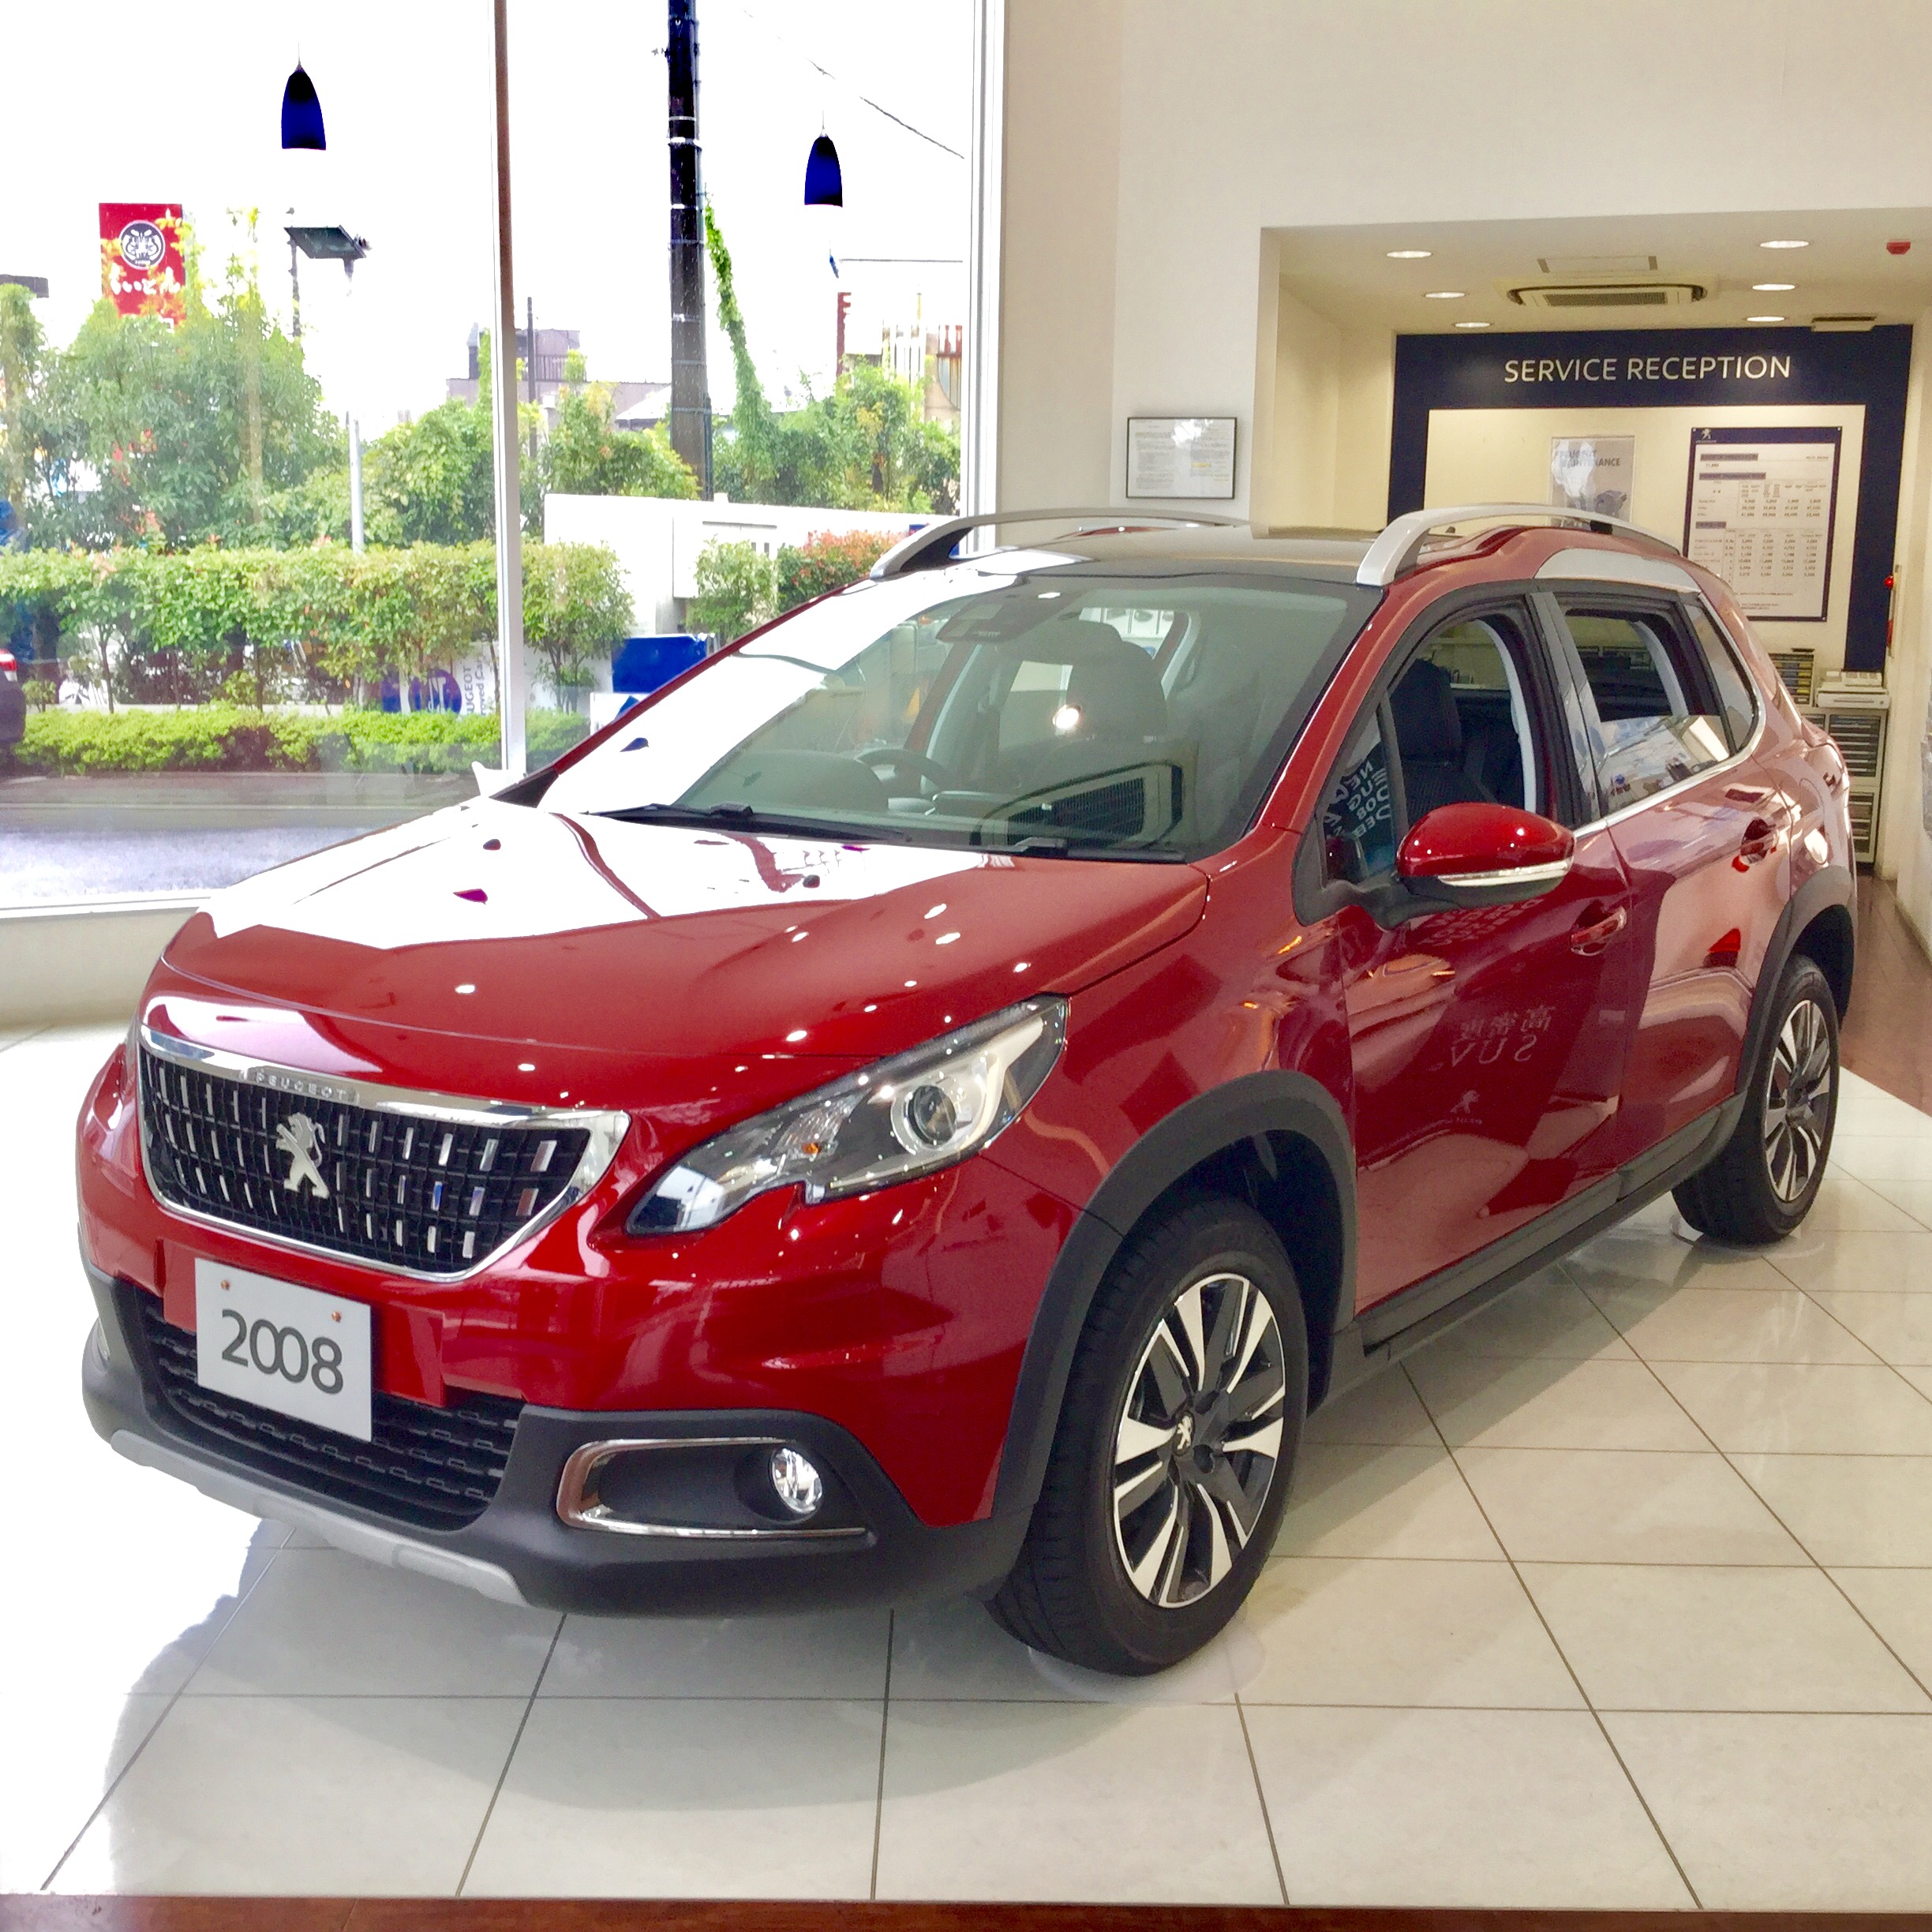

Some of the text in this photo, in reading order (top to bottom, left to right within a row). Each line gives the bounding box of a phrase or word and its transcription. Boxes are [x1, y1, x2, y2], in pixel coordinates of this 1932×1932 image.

[1504, 355, 1791, 383] SERVICE RECEPTION
[462, 665, 475, 713] UGEOT
[255, 1069, 346, 1101] PEUGEOT
[221, 1308, 344, 1395] 2008
